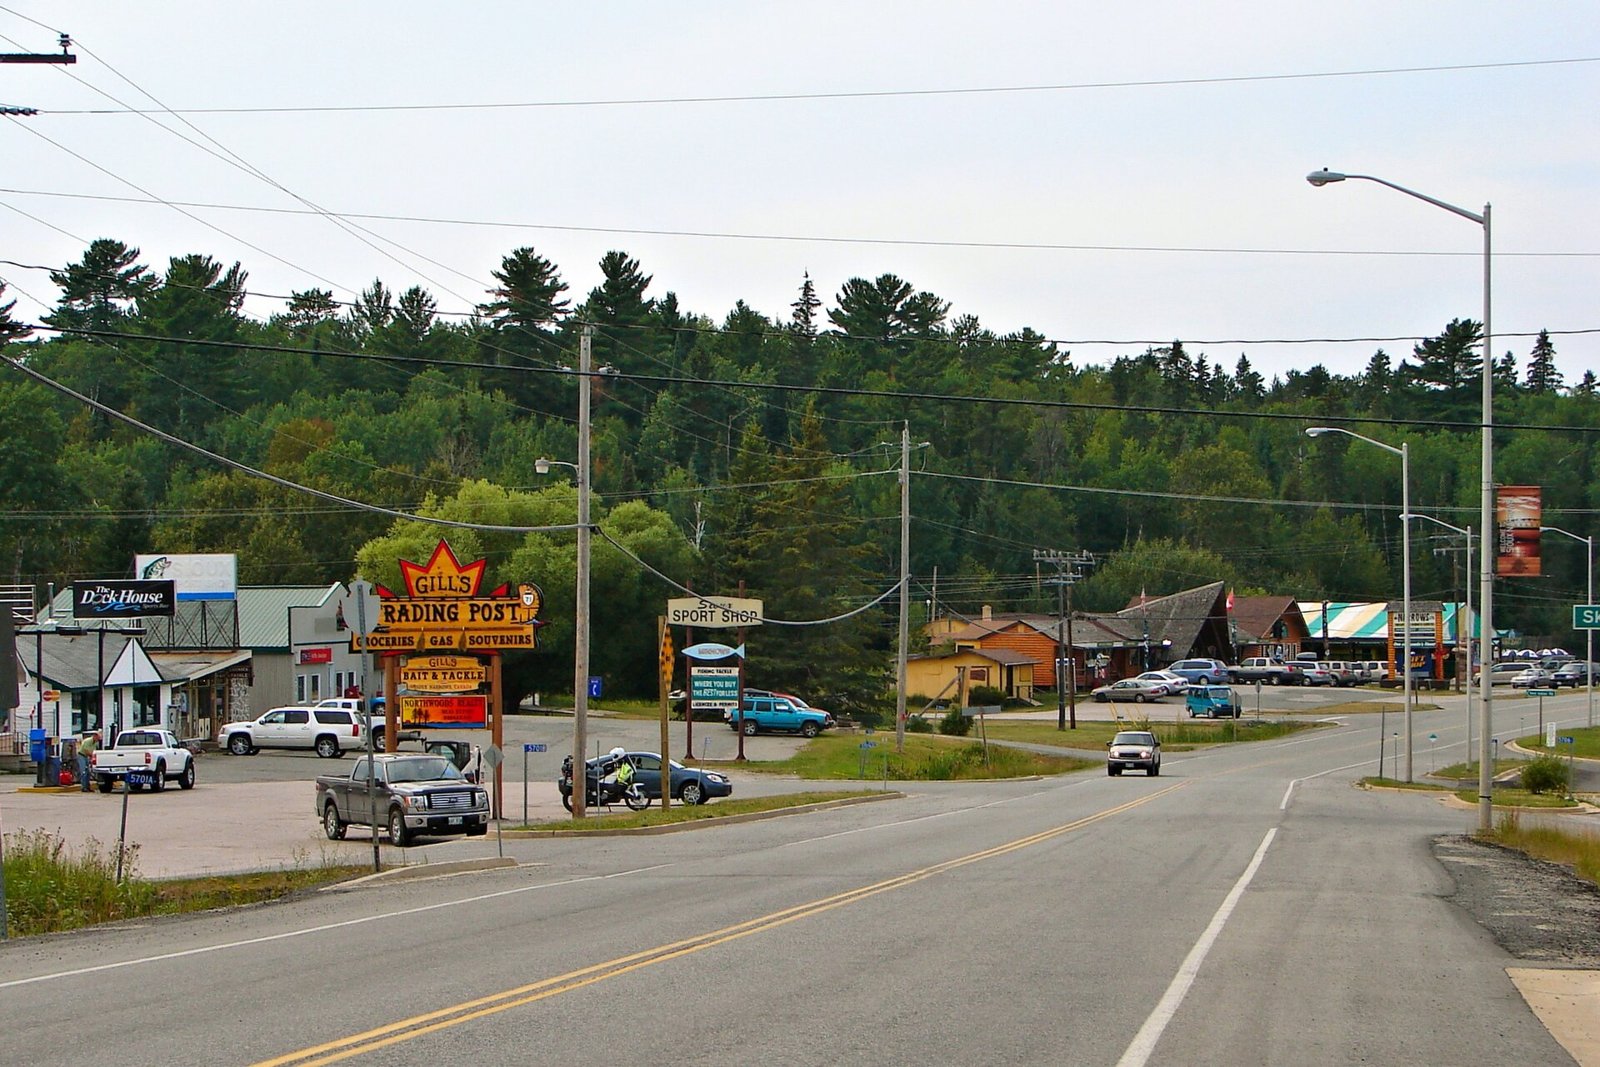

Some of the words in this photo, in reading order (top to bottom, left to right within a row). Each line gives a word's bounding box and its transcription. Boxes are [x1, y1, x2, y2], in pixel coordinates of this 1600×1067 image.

[95, 585, 111, 594] The
[415, 576, 472, 593] GILL'S
[80, 590, 119, 605] Dock
[119, 590, 164, 604] House
[381, 603, 459, 623] RADING
[469, 602, 522, 623] POST
[672, 609, 715, 622] SPORT
[721, 610, 758, 622] SHOP
[430, 636, 453, 646] GAS
[469, 634, 532, 646] SOUVENIRS
[403, 671, 428, 680] BAIT
[431, 671, 438, 680] &
[442, 671, 484, 680] TACKLE
[693, 680, 713, 688] WHERE
[130, 775, 153, 785] 5701A
